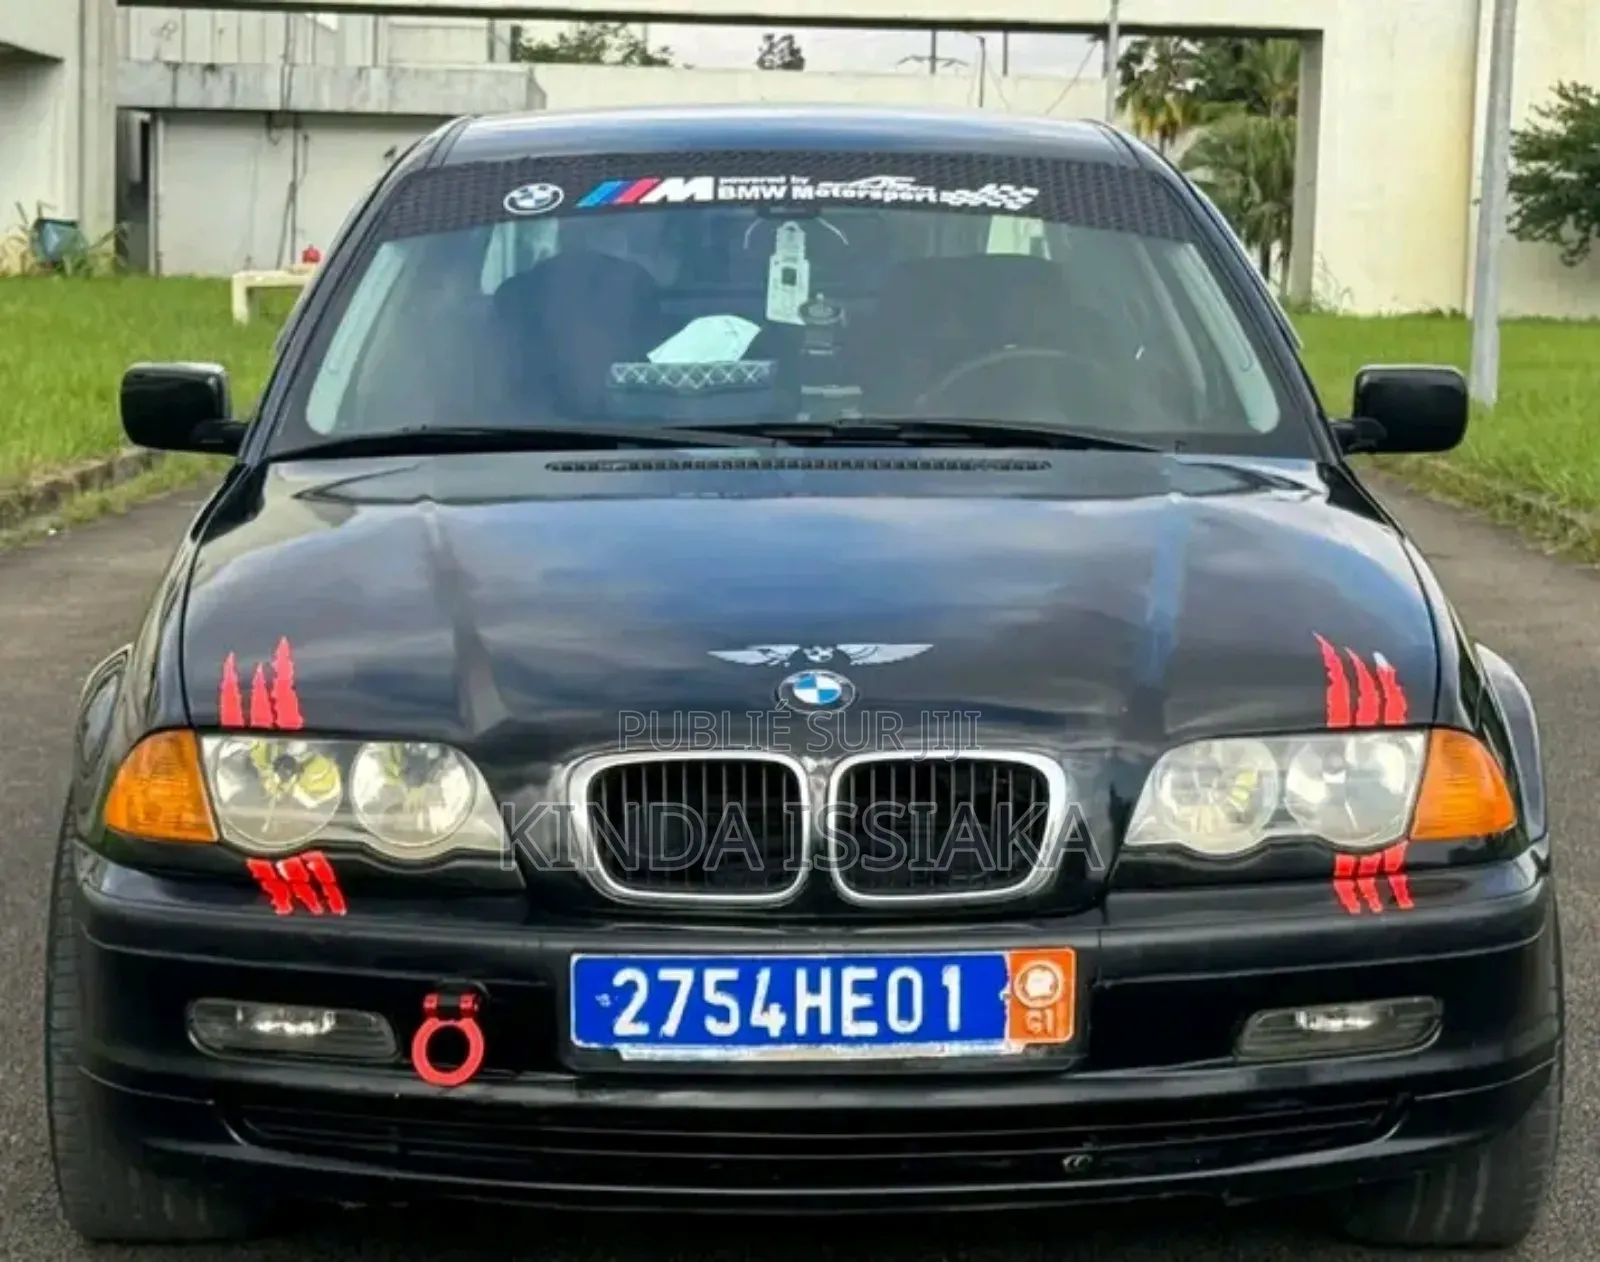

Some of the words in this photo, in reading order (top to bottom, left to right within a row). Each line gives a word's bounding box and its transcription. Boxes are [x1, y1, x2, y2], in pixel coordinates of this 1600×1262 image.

[718, 176, 787, 185] powered
[790, 175, 811, 186] by
[717, 184, 788, 200] BMW
[791, 183, 938, 204] Motorsport
[612, 966, 962, 1037] 2754HE01
